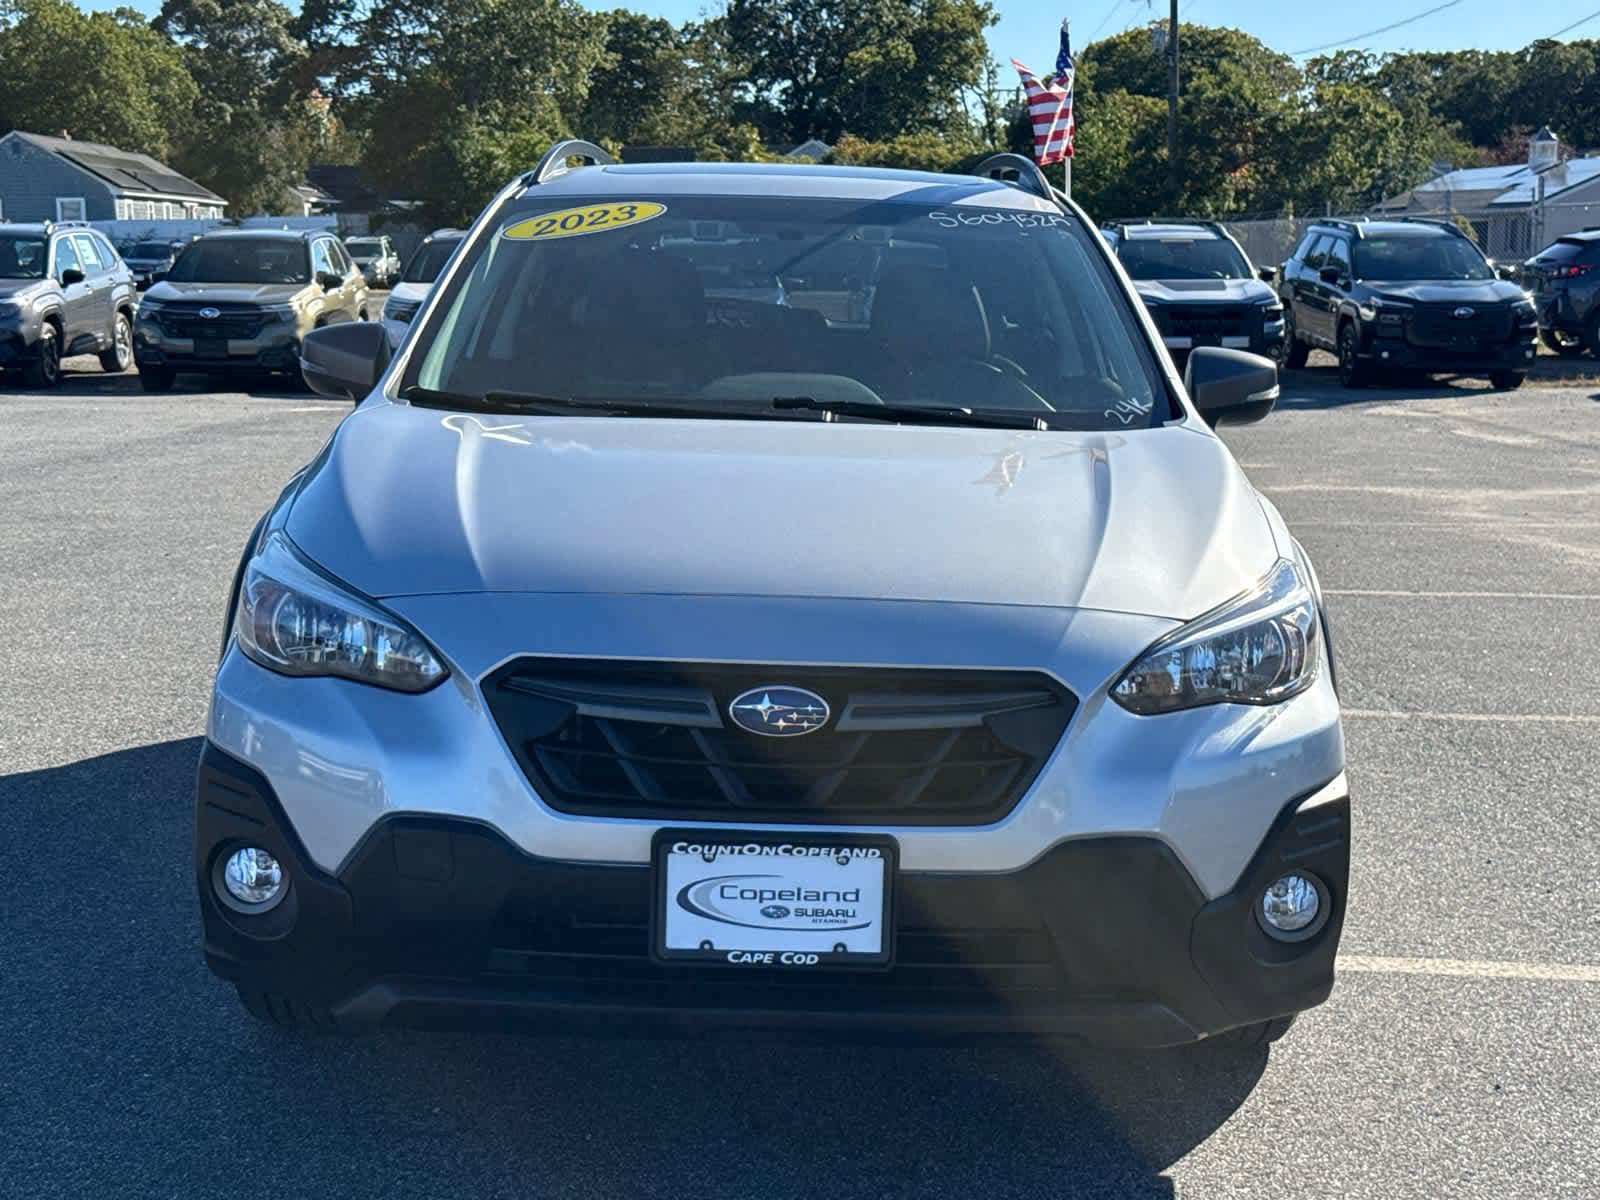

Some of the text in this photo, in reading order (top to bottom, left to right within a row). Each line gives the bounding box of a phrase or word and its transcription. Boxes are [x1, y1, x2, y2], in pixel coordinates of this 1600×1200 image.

[533, 205, 638, 236] 2023
[719, 885, 860, 904] Copeland
[794, 907, 856, 918] SUBARU
[727, 951, 820, 965] CAPE COD
